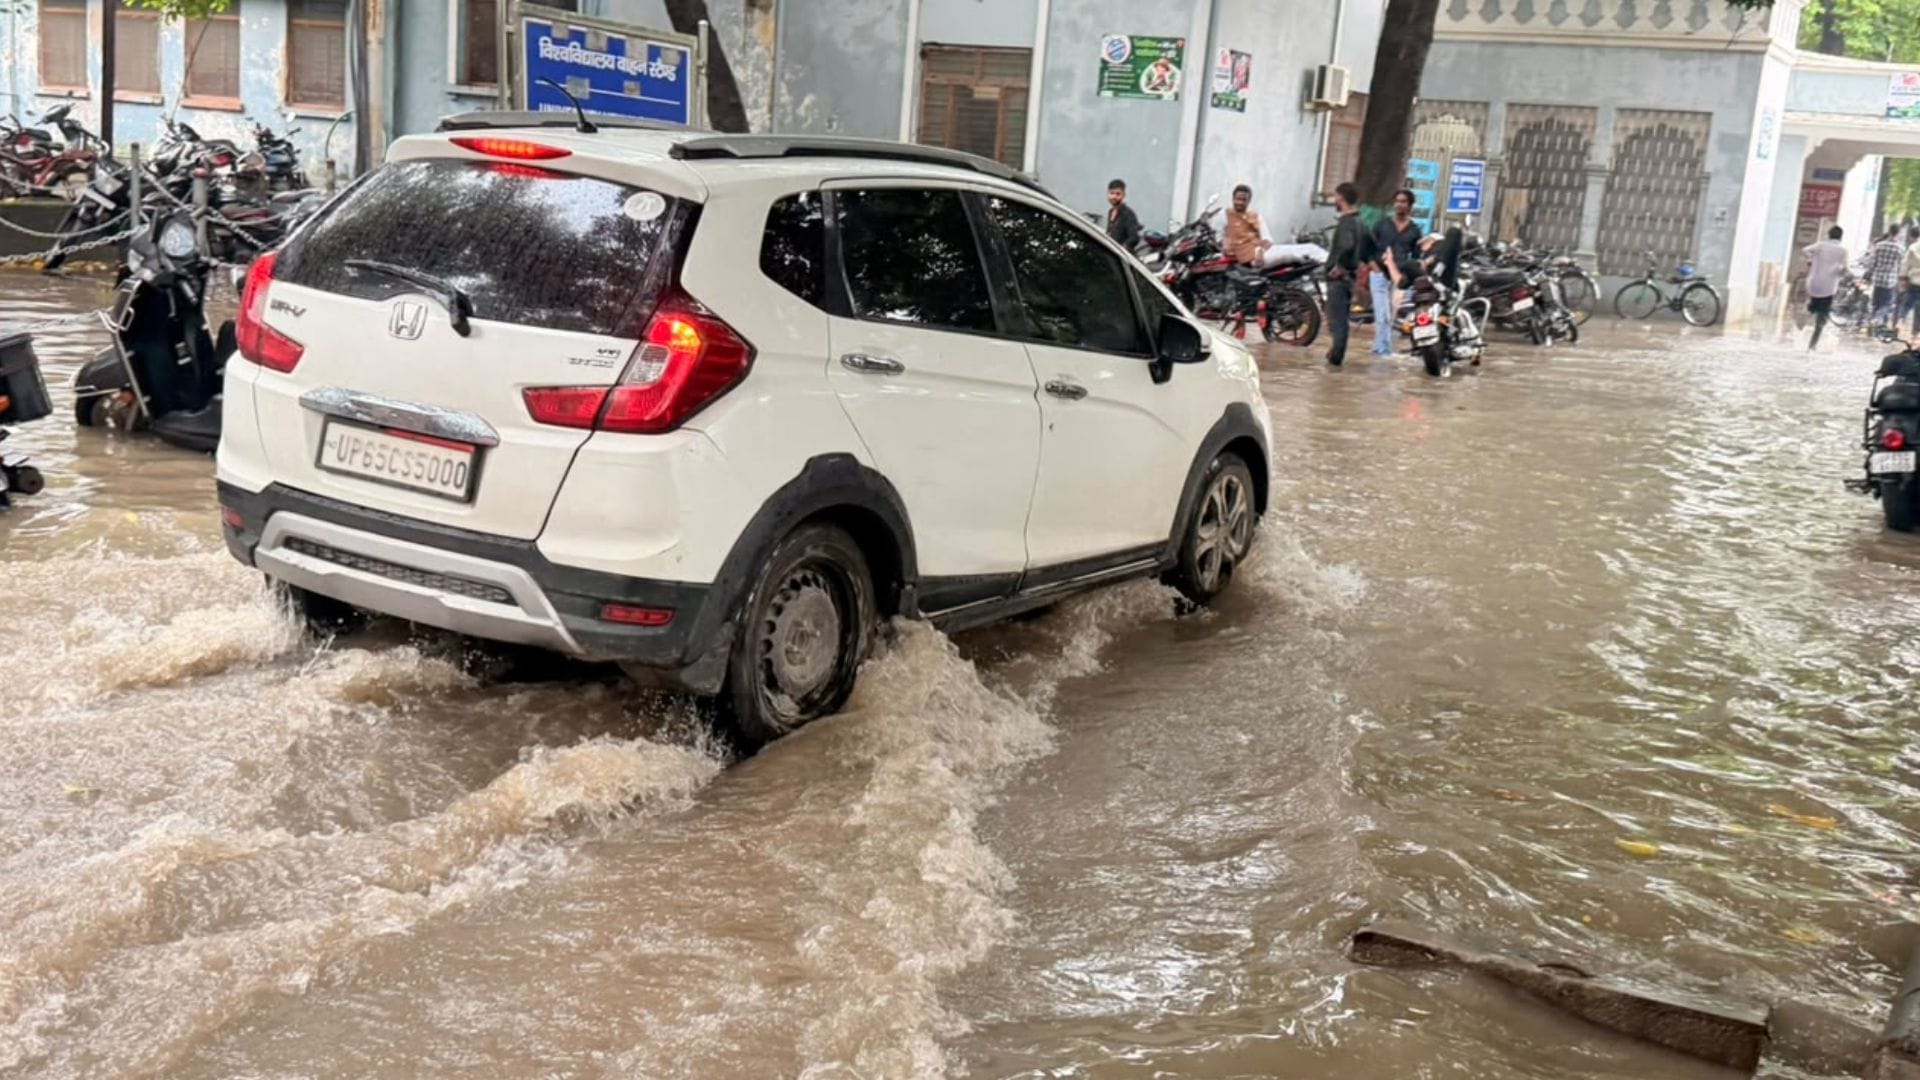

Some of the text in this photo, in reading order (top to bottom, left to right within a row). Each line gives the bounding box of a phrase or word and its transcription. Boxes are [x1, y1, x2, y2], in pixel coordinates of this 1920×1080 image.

[538, 37, 615, 69] विश्वविद्यालय
[617, 56, 647, 75] वाहन
[337, 434, 467, 489] UP65CS5000
